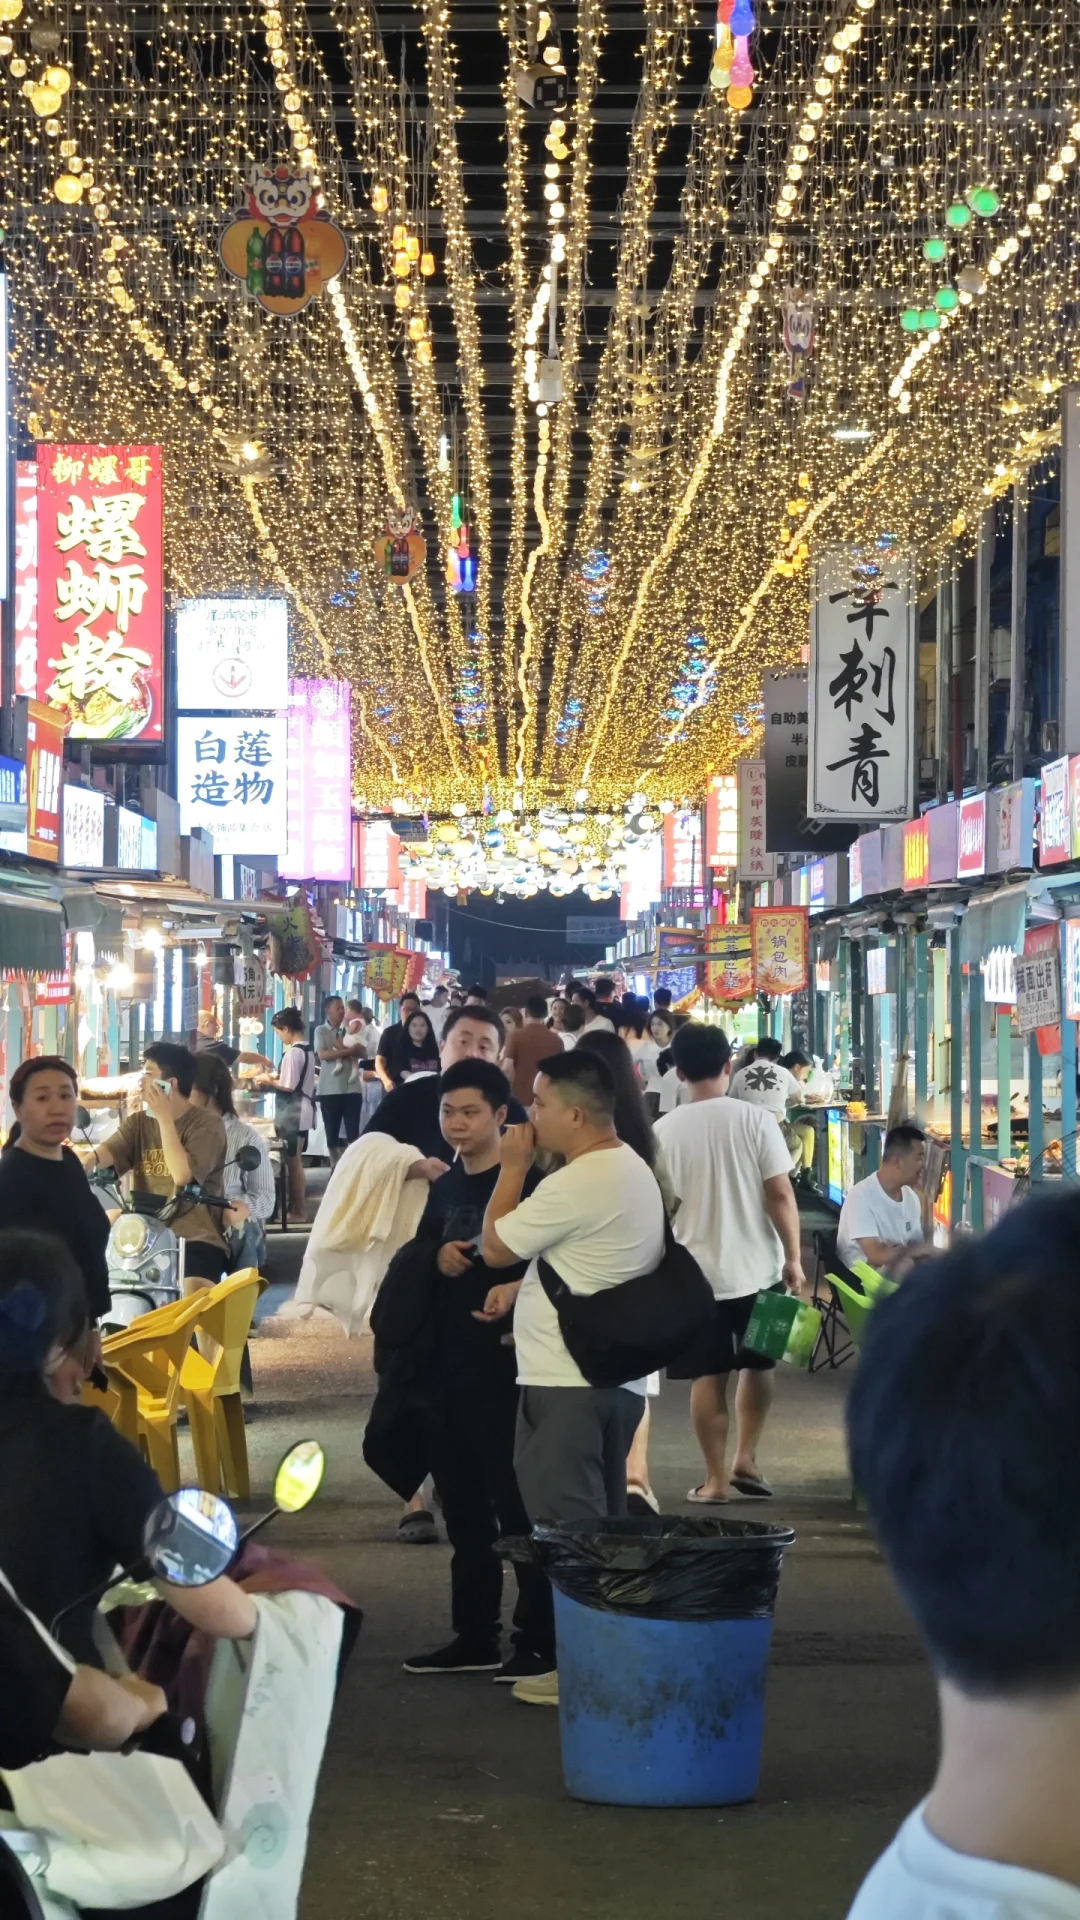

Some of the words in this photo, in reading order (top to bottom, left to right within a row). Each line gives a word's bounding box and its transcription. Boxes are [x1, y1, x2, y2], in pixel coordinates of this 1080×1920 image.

[52, 494, 152, 702] 螺蛳粉
[195, 729, 274, 767] 白莲
[190, 770, 275, 807] 造物
[771, 935, 789, 979] 锅包肉
